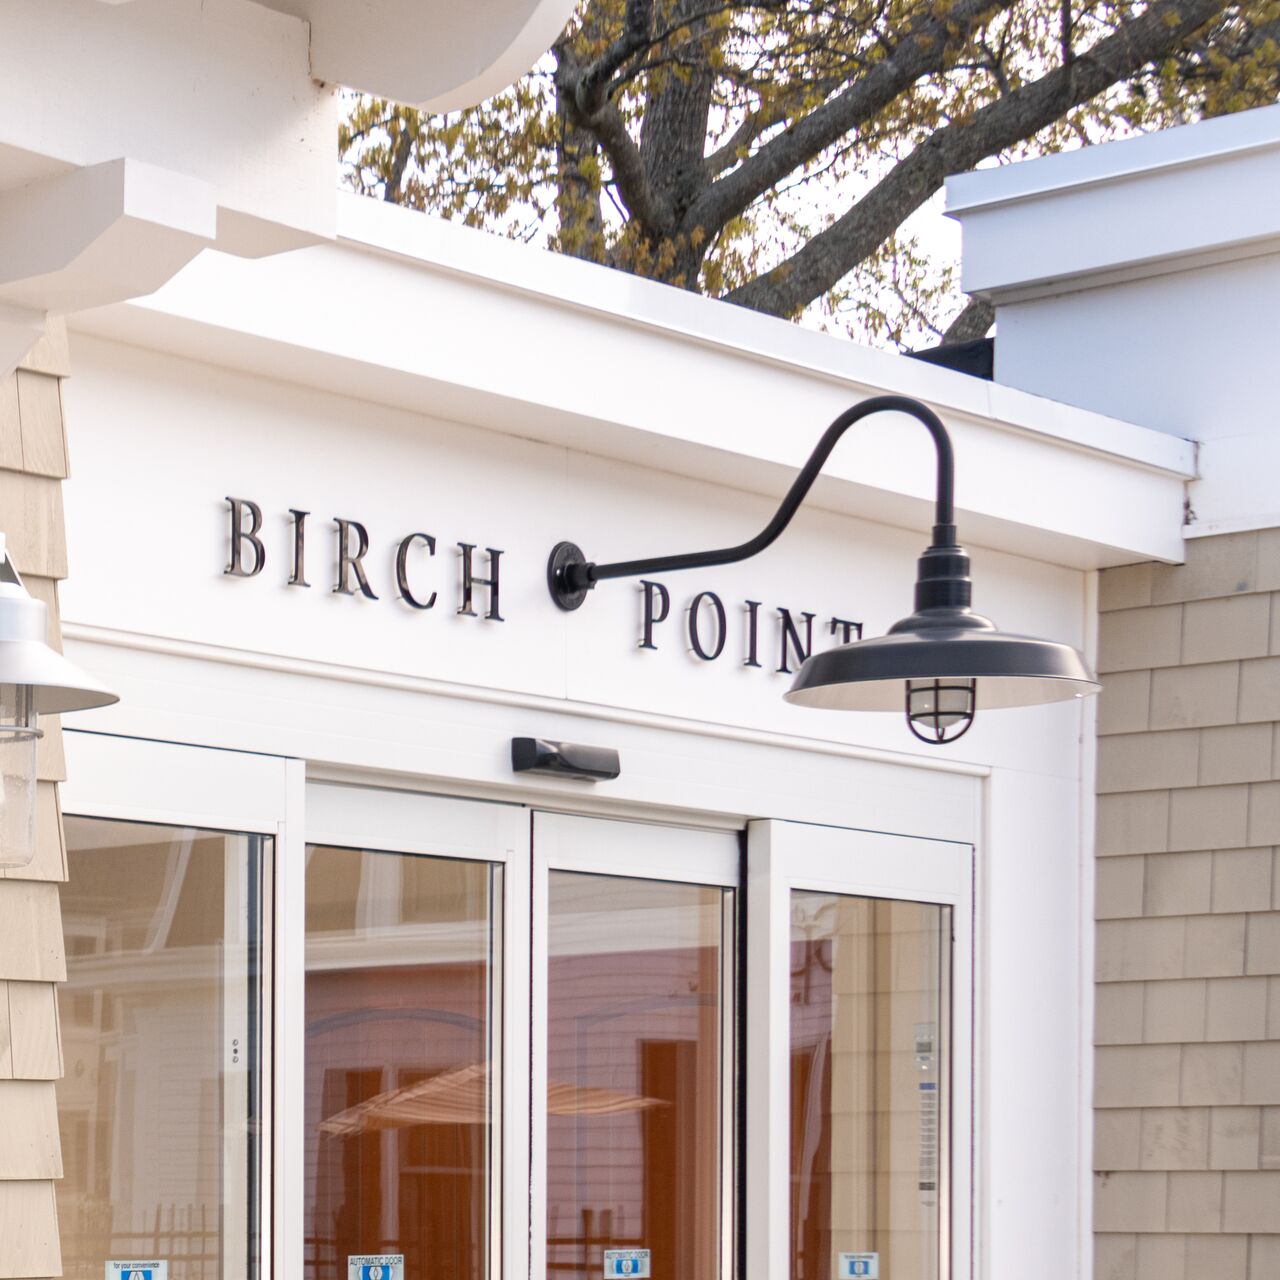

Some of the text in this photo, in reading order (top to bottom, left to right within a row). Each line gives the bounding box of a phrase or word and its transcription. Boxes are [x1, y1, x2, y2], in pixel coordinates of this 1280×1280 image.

[223, 496, 864, 674] BIRCH POINT
[350, 1255, 403, 1266] AUTOMATIC DOOR
